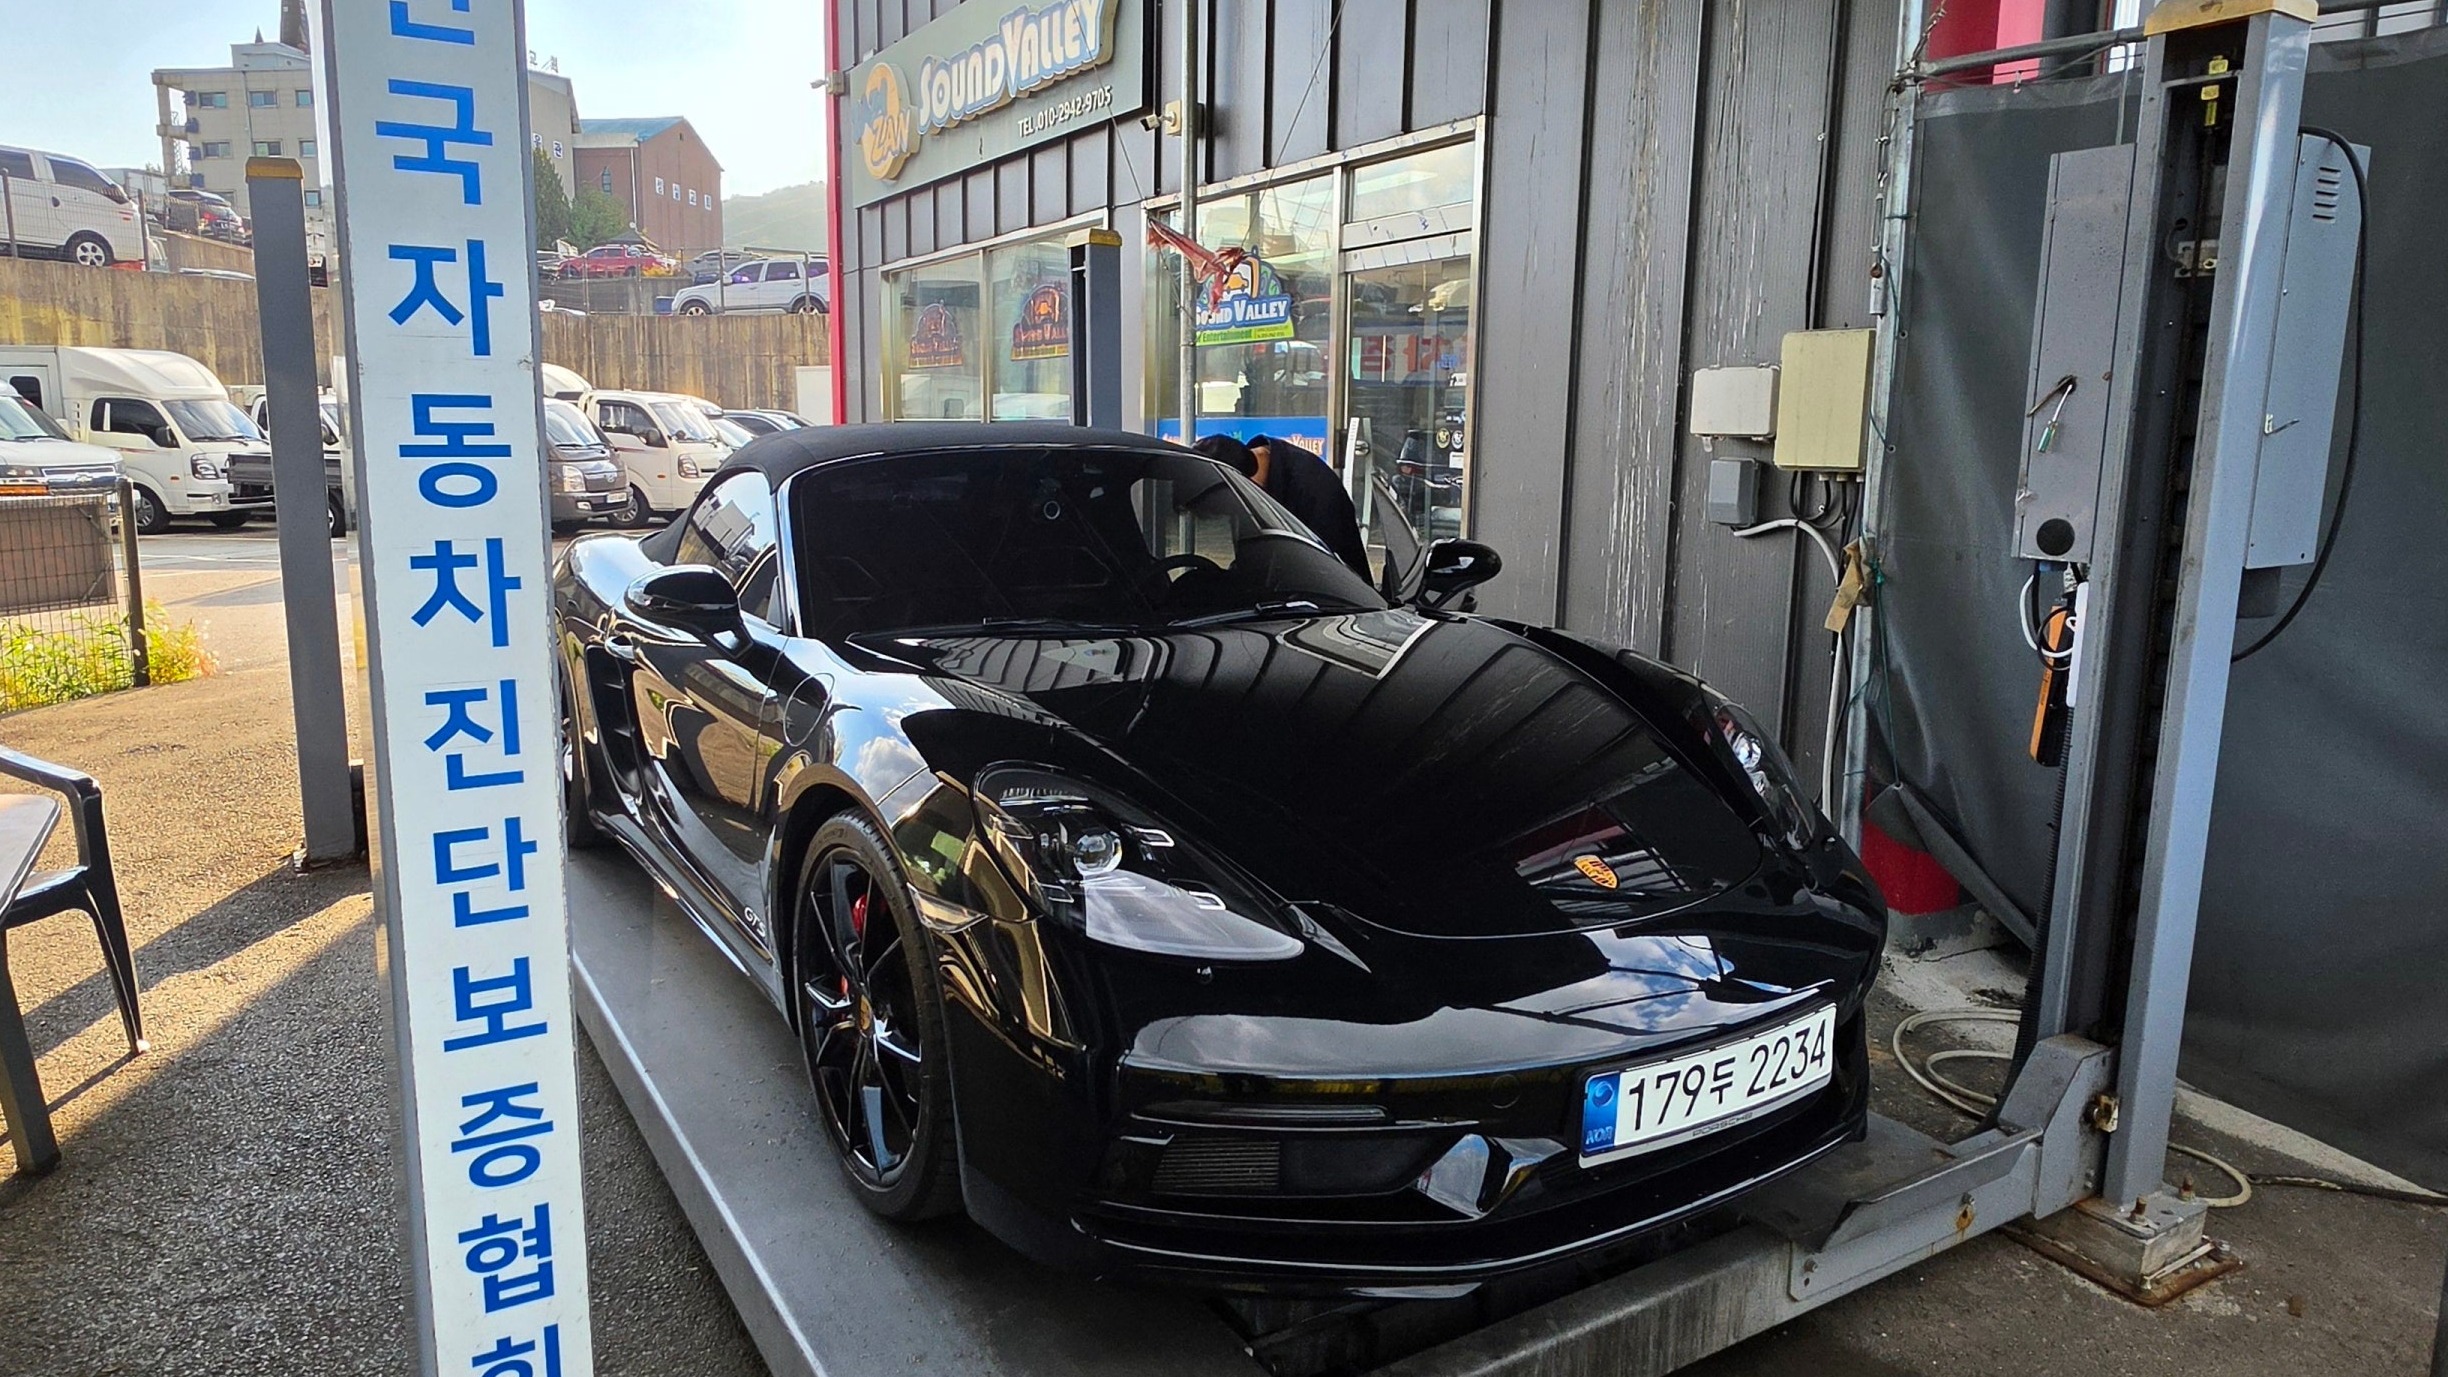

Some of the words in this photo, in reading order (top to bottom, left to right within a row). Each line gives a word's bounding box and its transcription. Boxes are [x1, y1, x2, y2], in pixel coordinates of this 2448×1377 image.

[744, 906, 767, 937] GTS
[1628, 1056, 1736, 1132] 179두
[1746, 1018, 1827, 1098] 2234
